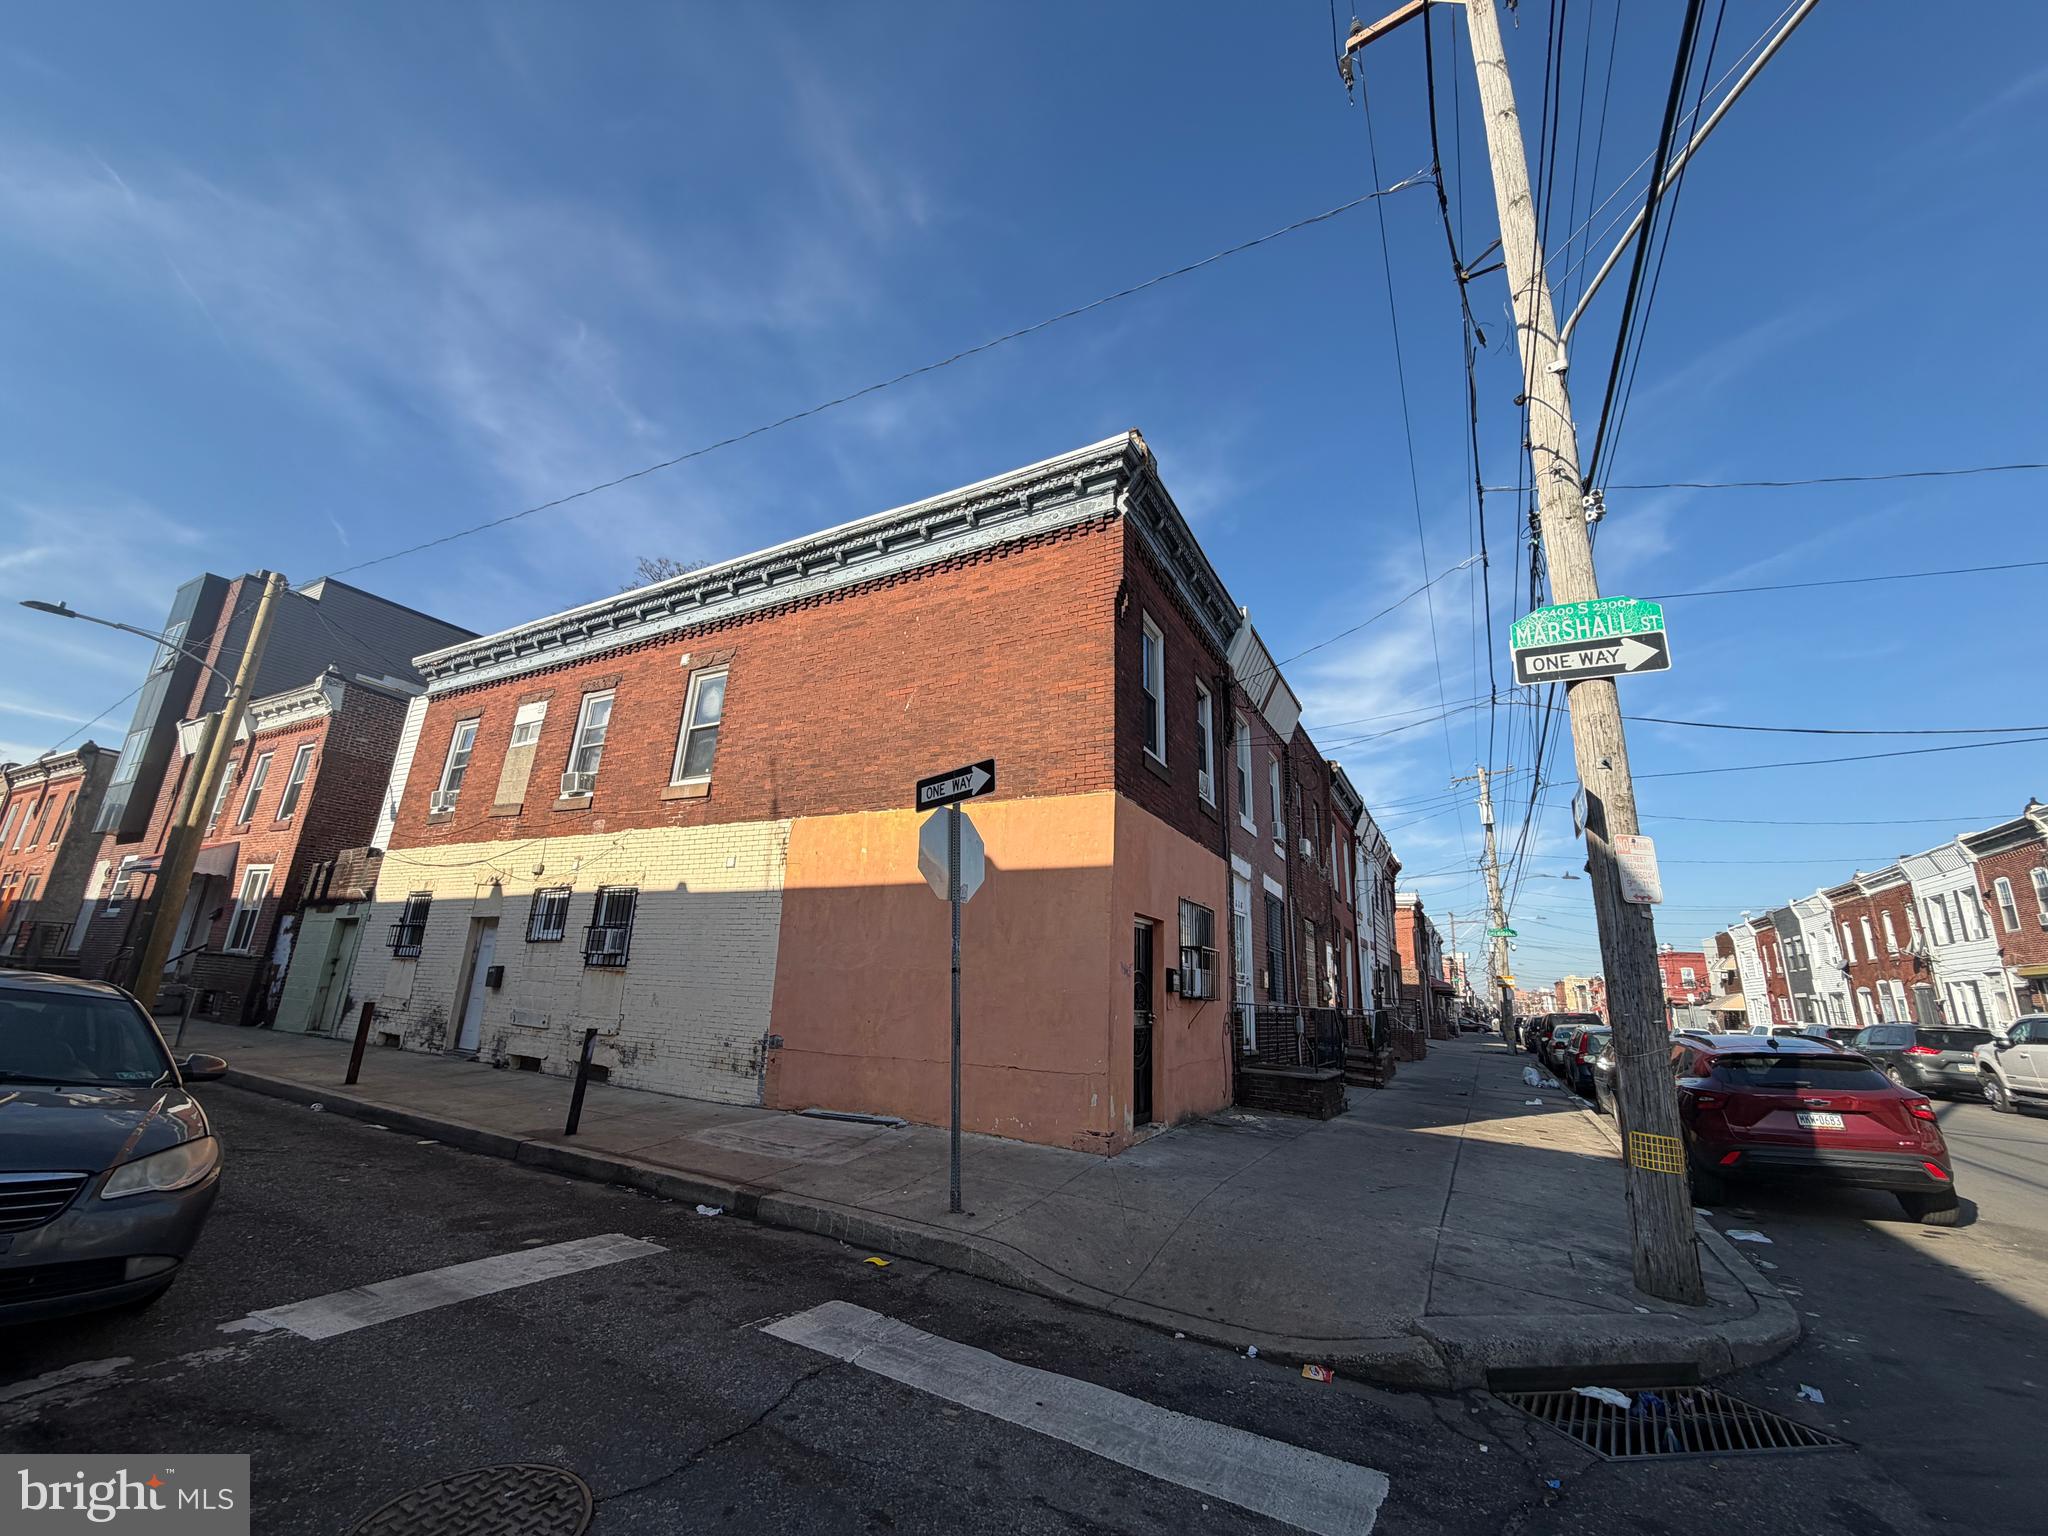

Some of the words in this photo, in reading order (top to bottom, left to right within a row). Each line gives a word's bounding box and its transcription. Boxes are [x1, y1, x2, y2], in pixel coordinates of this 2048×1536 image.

[1542, 606, 1574, 618] 2400
[1577, 603, 1588, 614] S
[1593, 599, 1626, 611] 2300
[1516, 613, 1632, 647] MARSHALL
[1640, 615, 1662, 631] ST
[1533, 654, 1571, 672] ONE
[1578, 648, 1620, 666] WAY
[926, 783, 946, 800] ONE
[952, 774, 973, 793] WAY
[1616, 837, 1629, 852] NO
